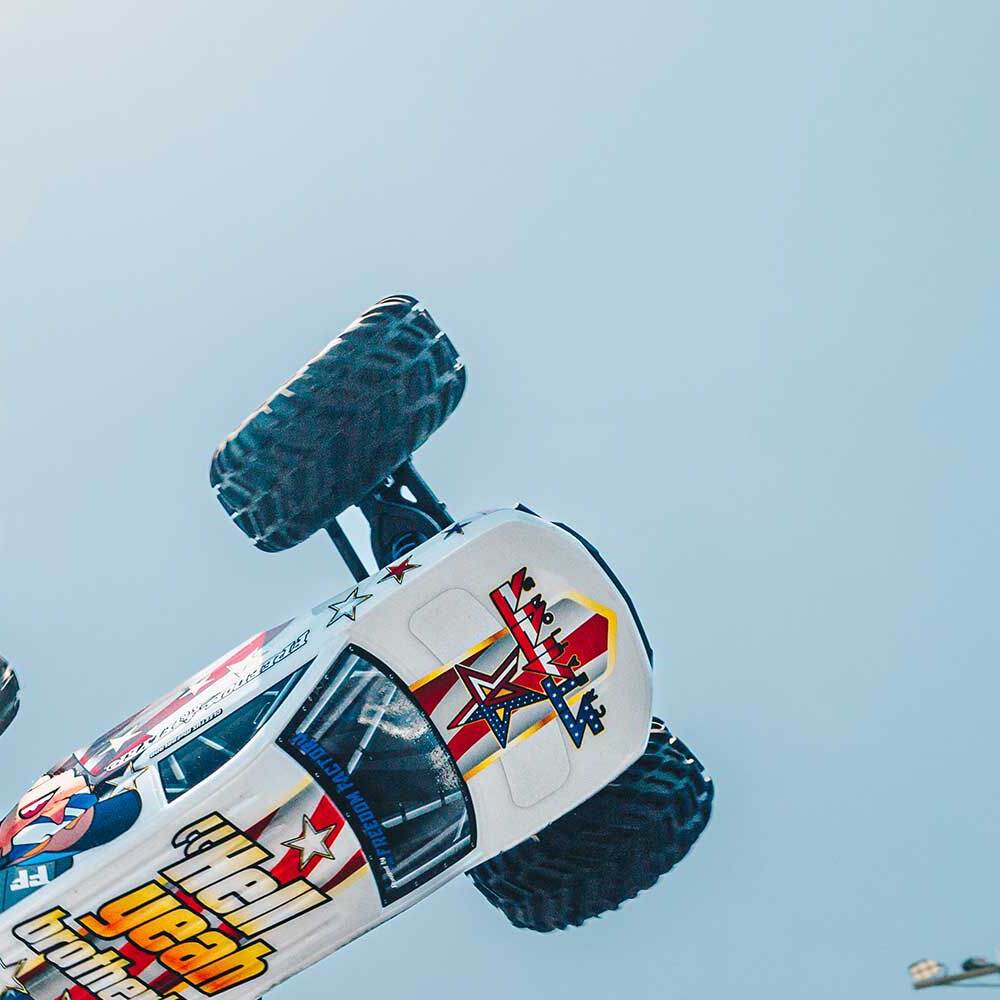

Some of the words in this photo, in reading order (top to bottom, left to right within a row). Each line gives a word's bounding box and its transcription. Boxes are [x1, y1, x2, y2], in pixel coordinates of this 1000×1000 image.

[522, 576, 607, 719] CREATIONS
[345, 789, 391, 858] FREEDOM
[74, 879, 278, 997] yeah
